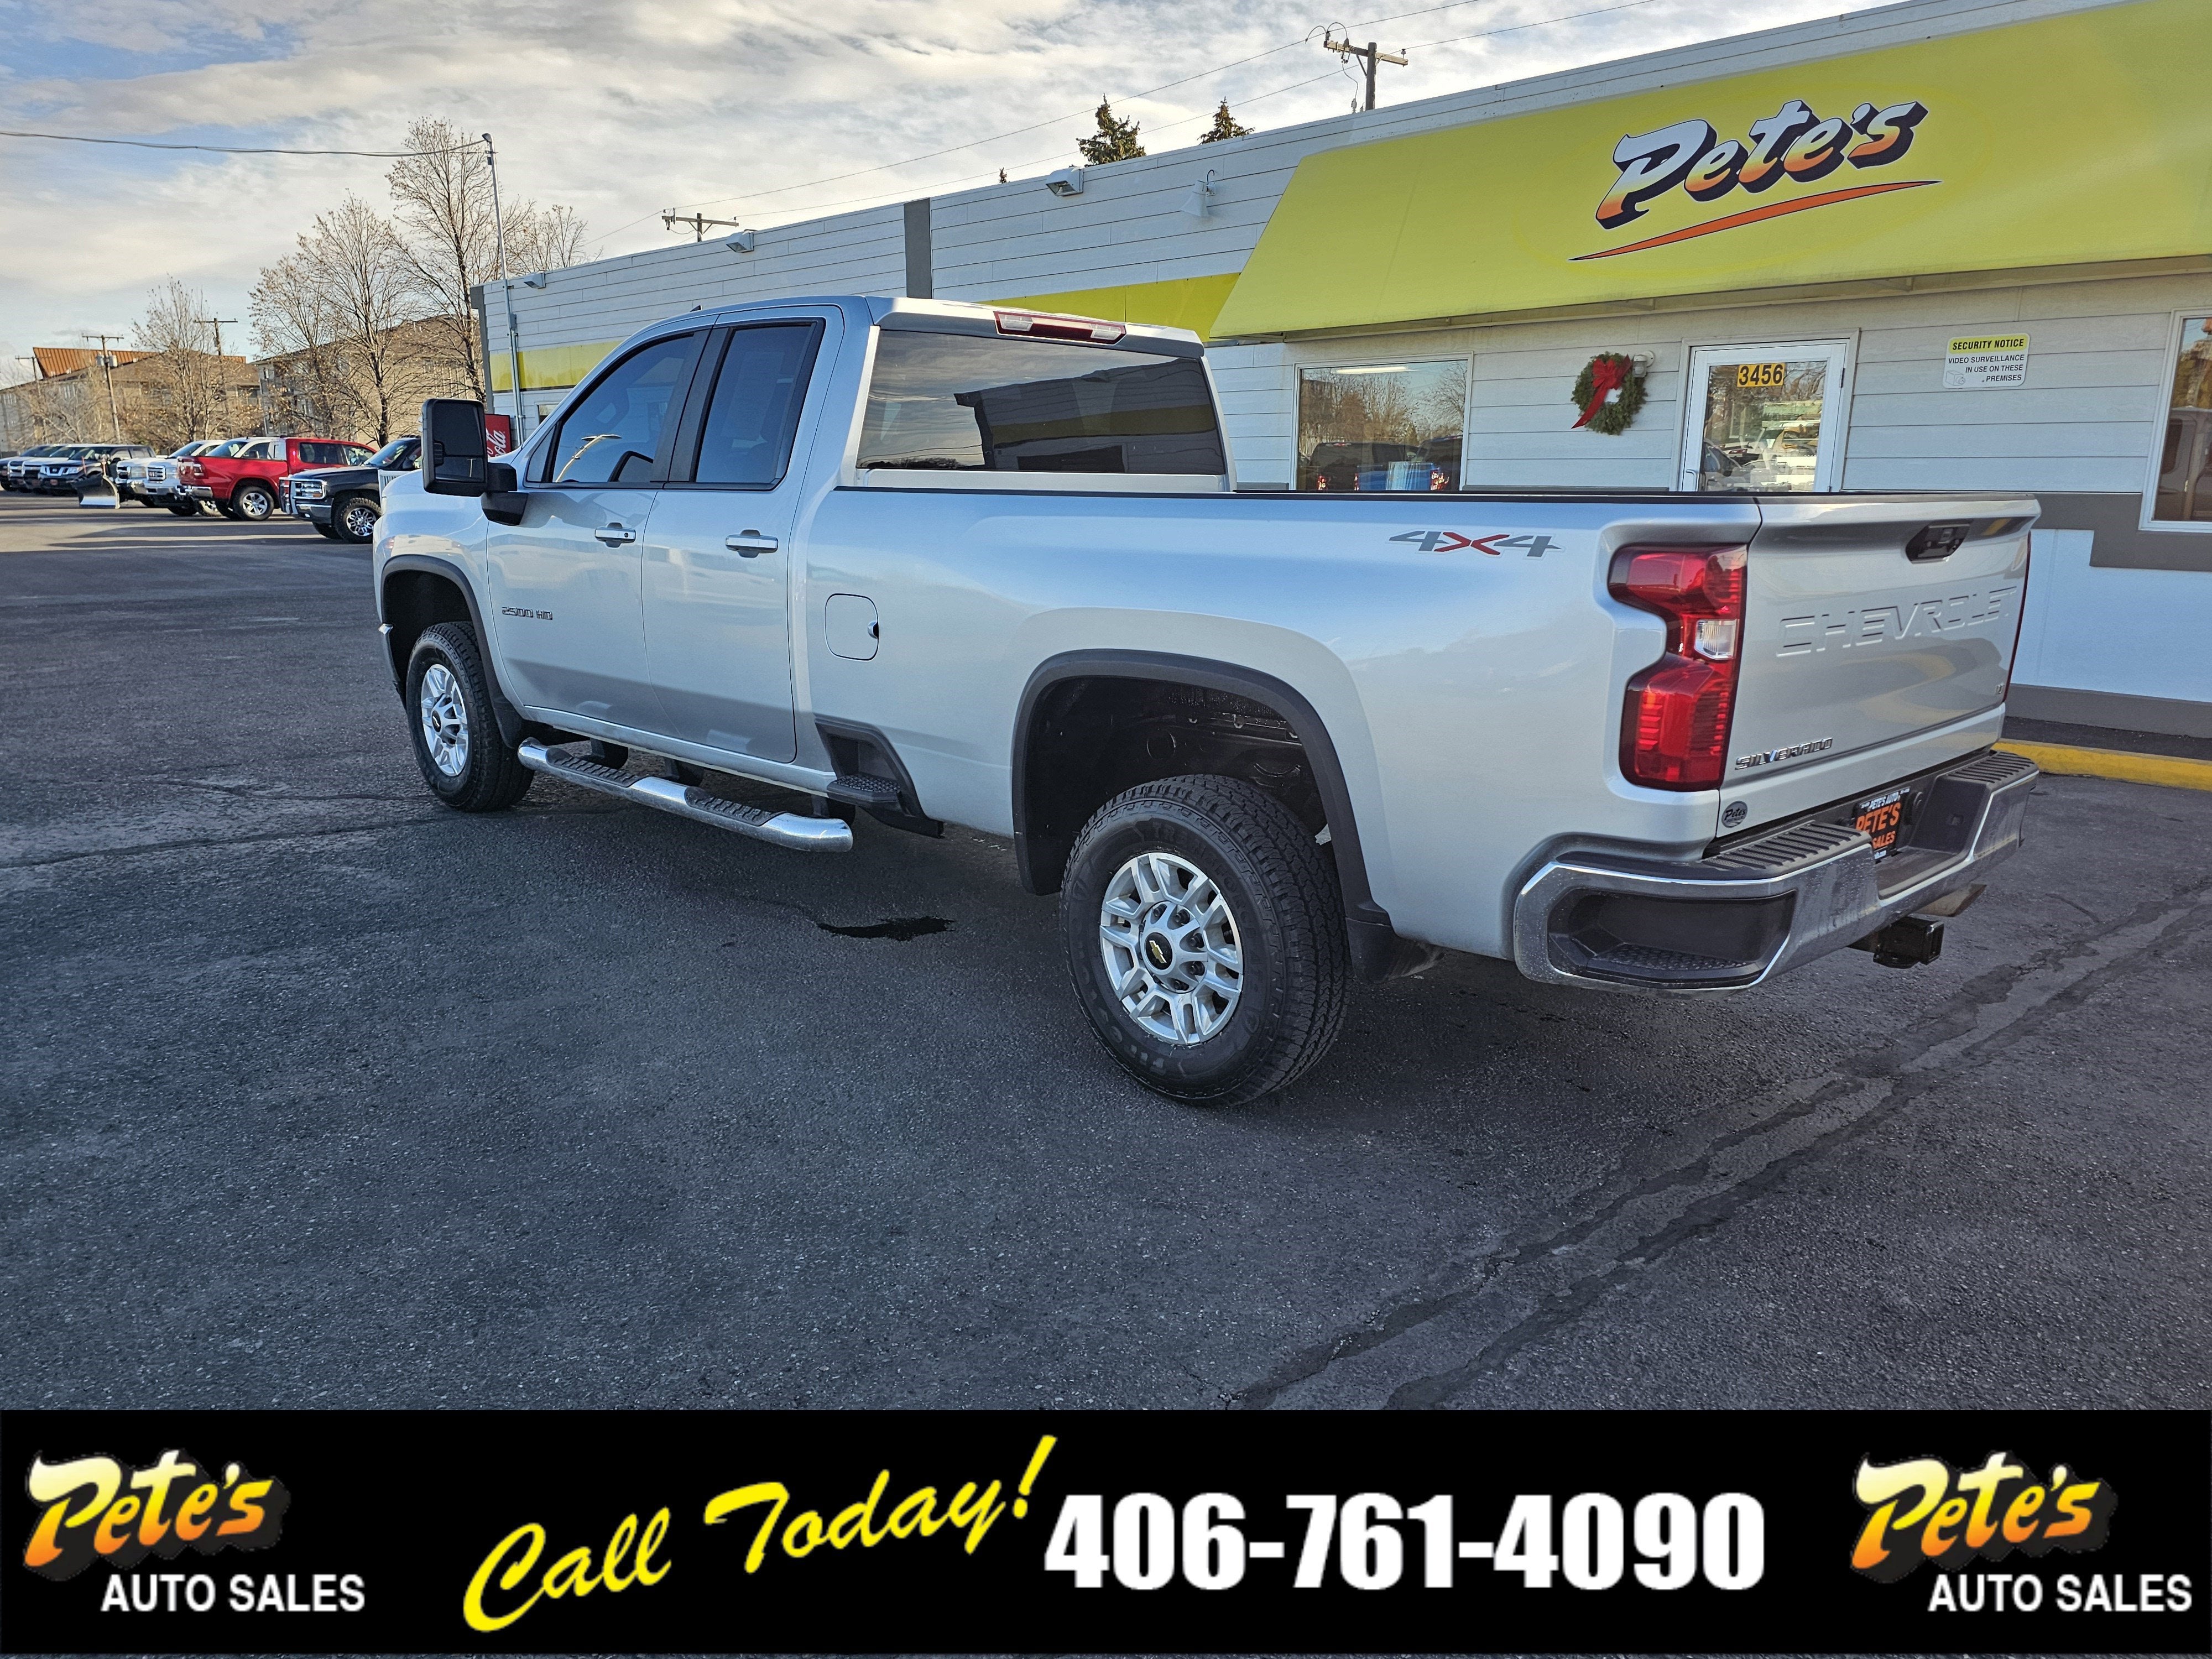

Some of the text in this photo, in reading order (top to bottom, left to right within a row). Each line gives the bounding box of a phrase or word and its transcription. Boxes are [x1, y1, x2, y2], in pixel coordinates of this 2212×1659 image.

[1595, 100, 1929, 229] Pete's
[1953, 338, 2024, 350] SECURITY NOTICE
[1971, 354, 2025, 363] SURVEILLANCE
[1739, 364, 1783, 385] 3456
[502, 606, 553, 620] 2500 HD
[1776, 586, 2017, 657] CHEVROLET
[1735, 737, 1833, 770] SILVERADO
[1856, 802, 1901, 833] PETE'S
[1872, 831, 1896, 849] SALES
